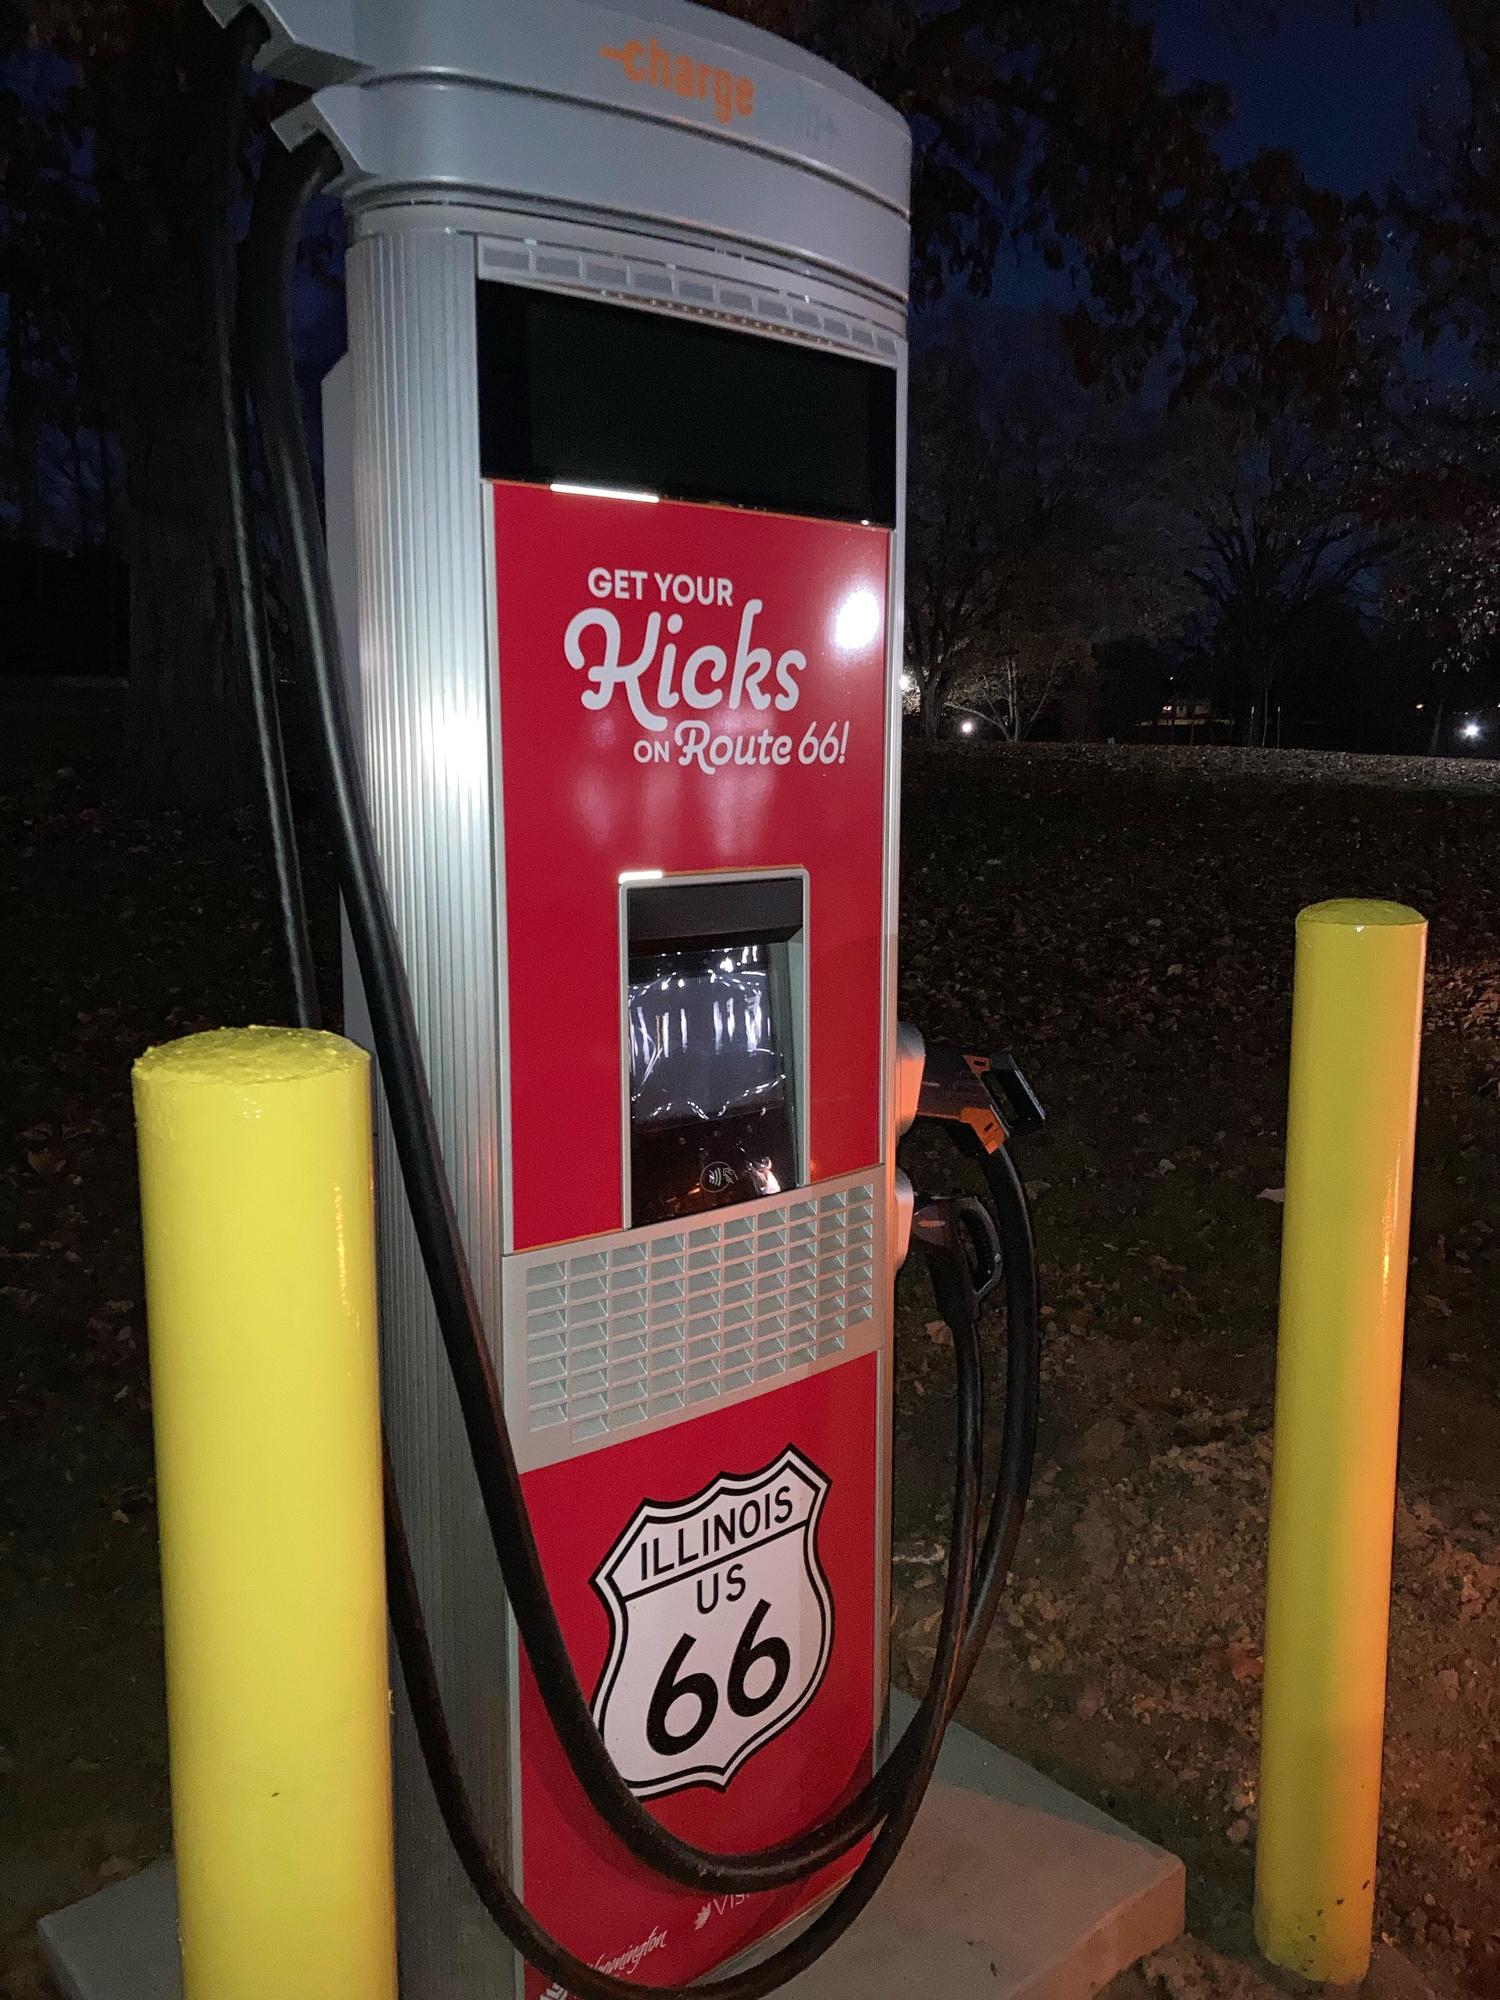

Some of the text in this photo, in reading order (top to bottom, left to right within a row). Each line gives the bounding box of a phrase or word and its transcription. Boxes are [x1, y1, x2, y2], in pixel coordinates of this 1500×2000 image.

[599, 32, 755, 124] charge
[587, 566, 733, 607] GET YOUR
[564, 598, 807, 731] Kicks
[633, 719, 850, 775] ON Route 66!
[640, 1485, 793, 1581] ILLINOIS
[696, 1563, 746, 1615] US
[646, 1598, 791, 1756] 66
